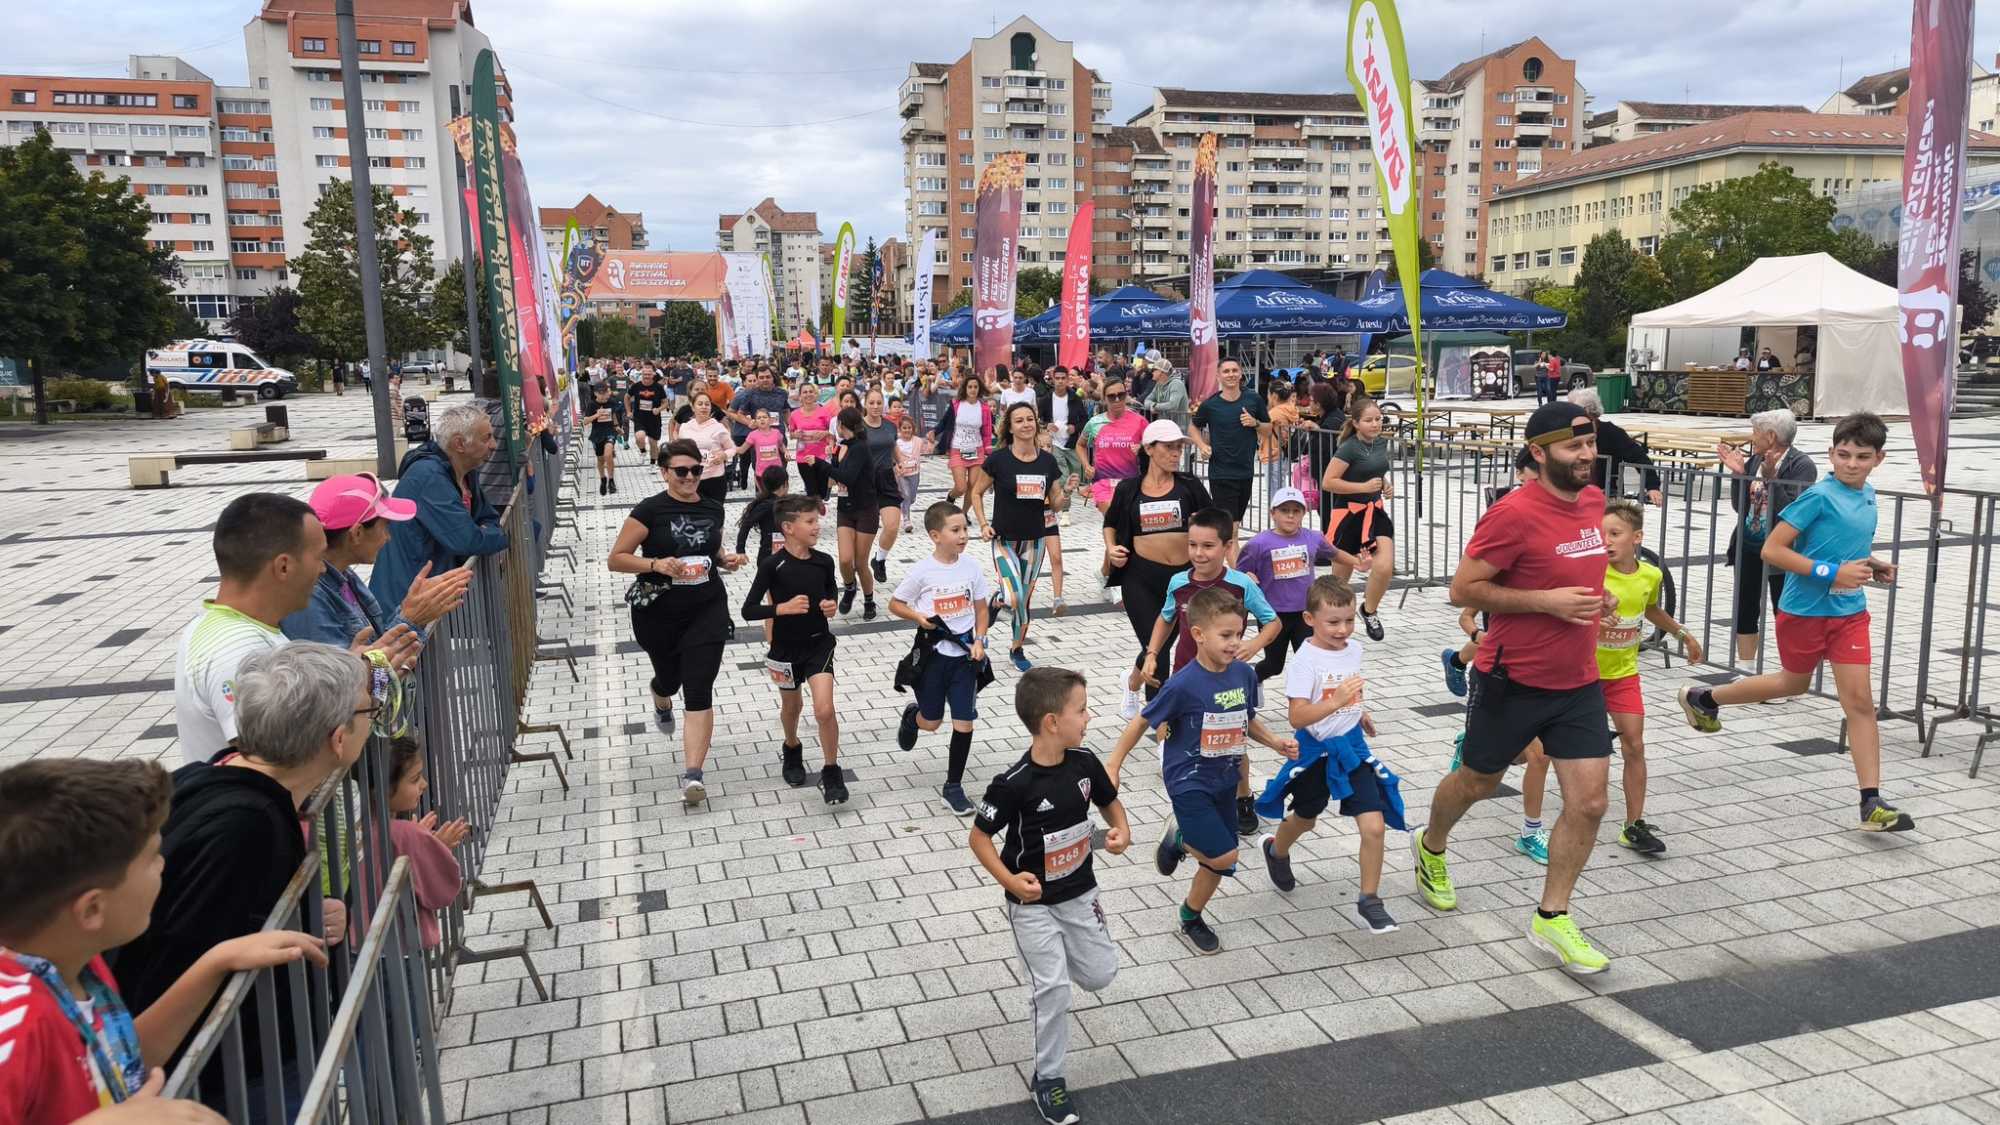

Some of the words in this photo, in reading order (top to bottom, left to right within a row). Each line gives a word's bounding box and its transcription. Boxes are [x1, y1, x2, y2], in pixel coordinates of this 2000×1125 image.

[981, 256, 990, 302] RUNNING
[990, 257, 1000, 302] FESTIVAL
[1076, 265, 1089, 339] OPTIKA
[1255, 295, 1319, 306] Artesia
[1216, 319, 1241, 329] Artesia
[938, 600, 958, 610] 1261
[1605, 630, 1627, 639] 1241
[1215, 687, 1246, 705] SONIC
[1207, 733, 1232, 745] 1272
[1051, 847, 1079, 867] 1268
